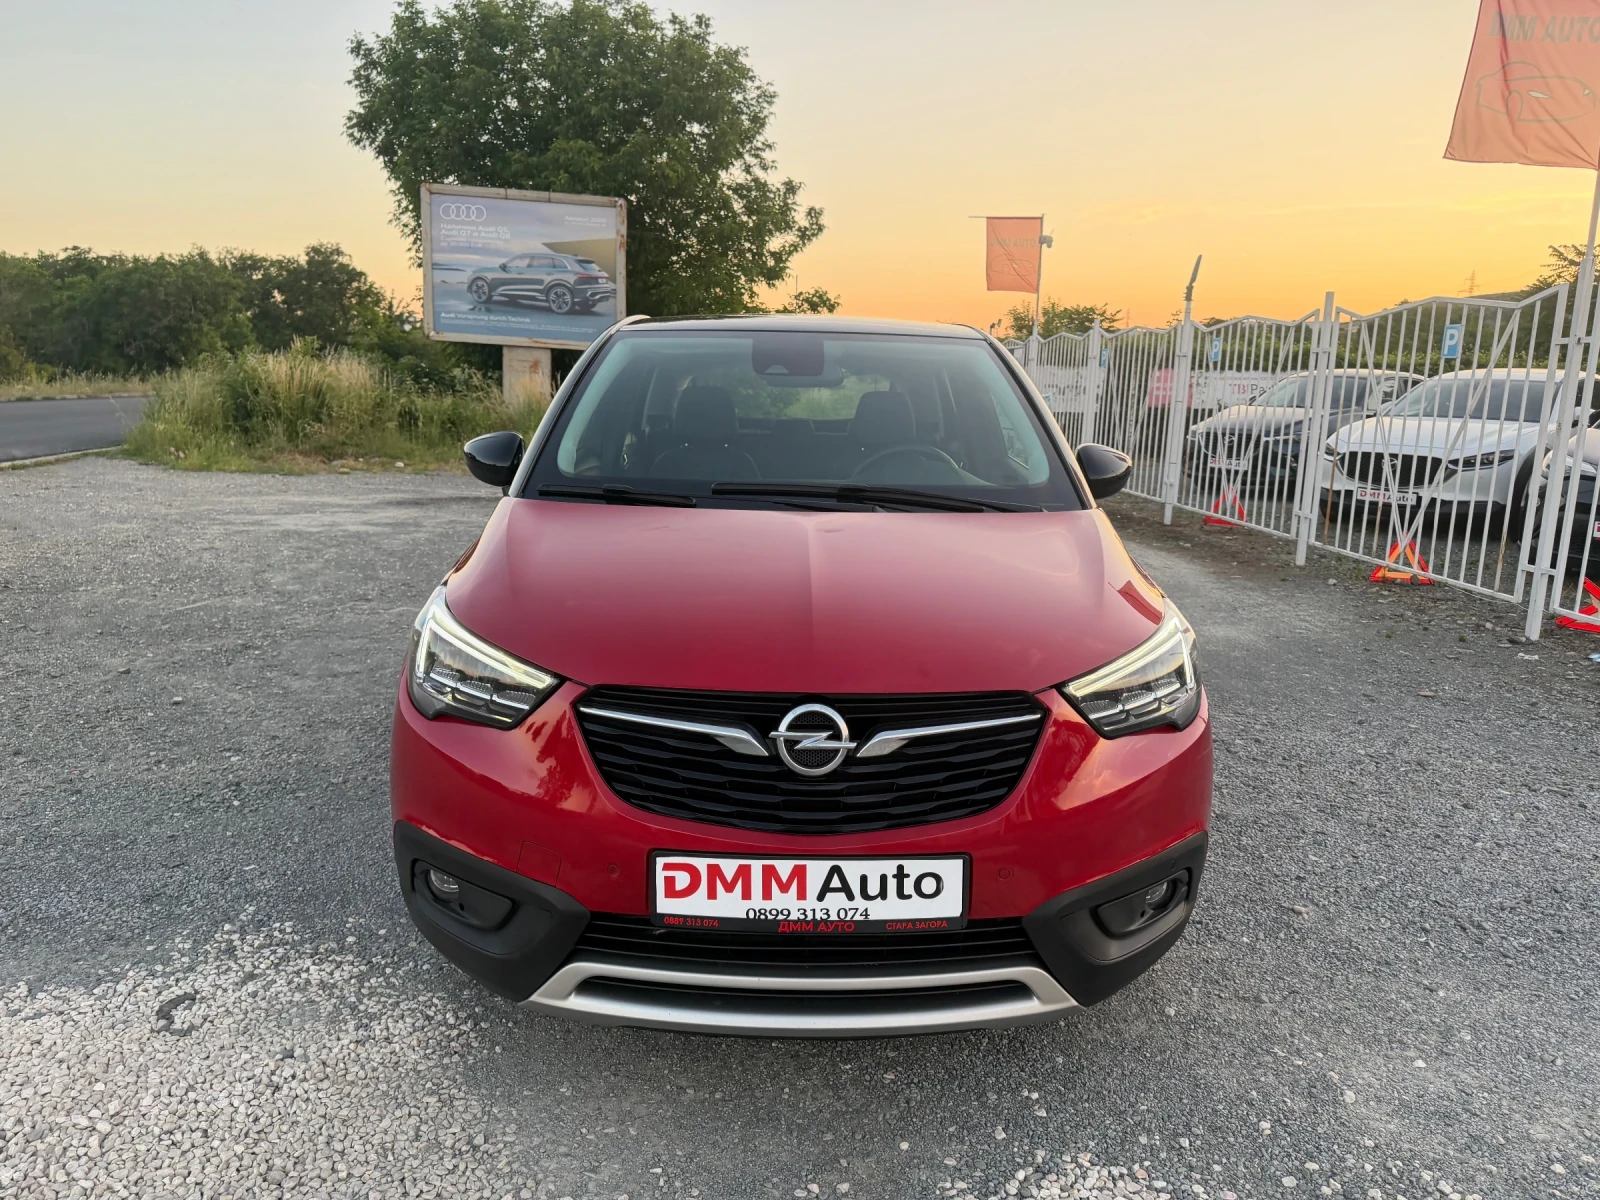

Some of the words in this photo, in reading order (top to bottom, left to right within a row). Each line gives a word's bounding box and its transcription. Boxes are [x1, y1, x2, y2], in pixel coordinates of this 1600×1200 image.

[745, 907, 791, 920] 0899
[797, 907, 830, 920] 313
[836, 907, 870, 920] 074
[663, 916, 684, 925] 0889
[686, 917, 701, 926] 313
[703, 919, 719, 927] 074
[778, 921, 813, 933] ДММ
[817, 921, 855, 932] АУТО
[885, 922, 914, 930] СТАРА
[915, 920, 948, 929] ЗАГОРА
